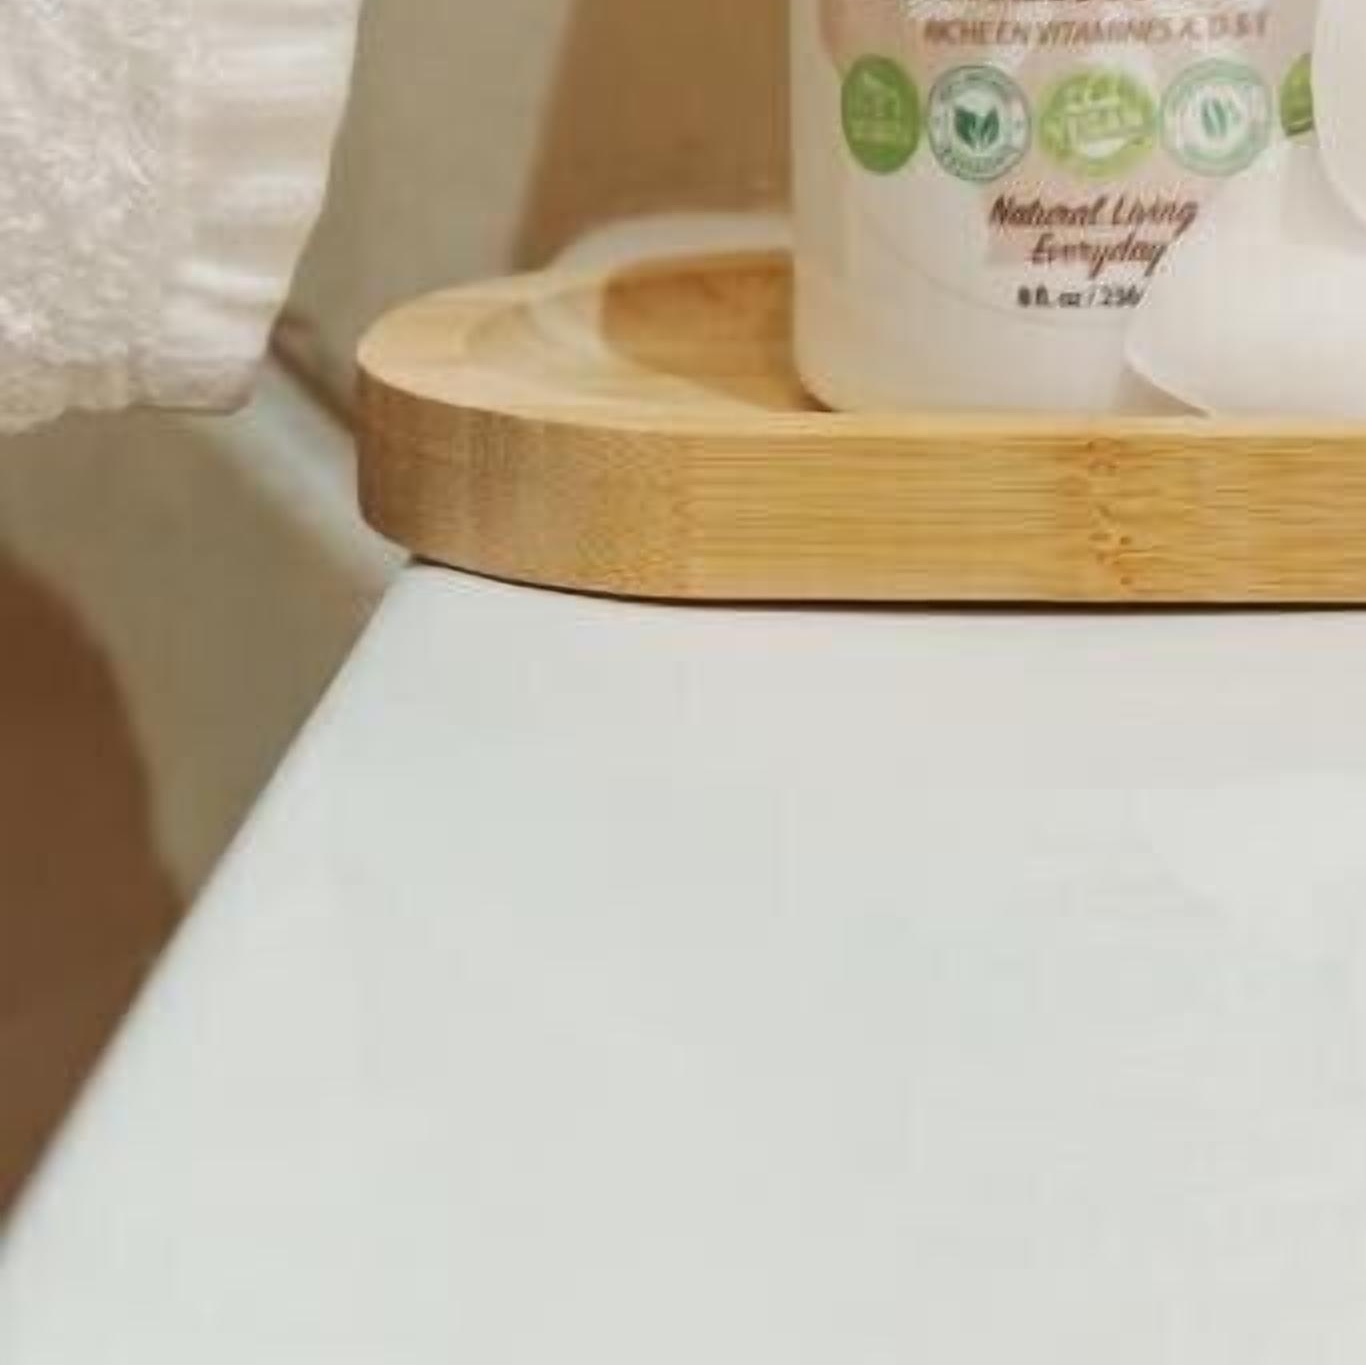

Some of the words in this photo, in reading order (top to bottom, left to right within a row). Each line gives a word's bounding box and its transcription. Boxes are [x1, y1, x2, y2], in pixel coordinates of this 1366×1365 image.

[989, 195, 1104, 227] Natural
[1111, 192, 1198, 239] Living
[1028, 234, 1170, 281] Everyday
[1017, 285, 1031, 308] 8
[1058, 291, 1082, 308] oz
